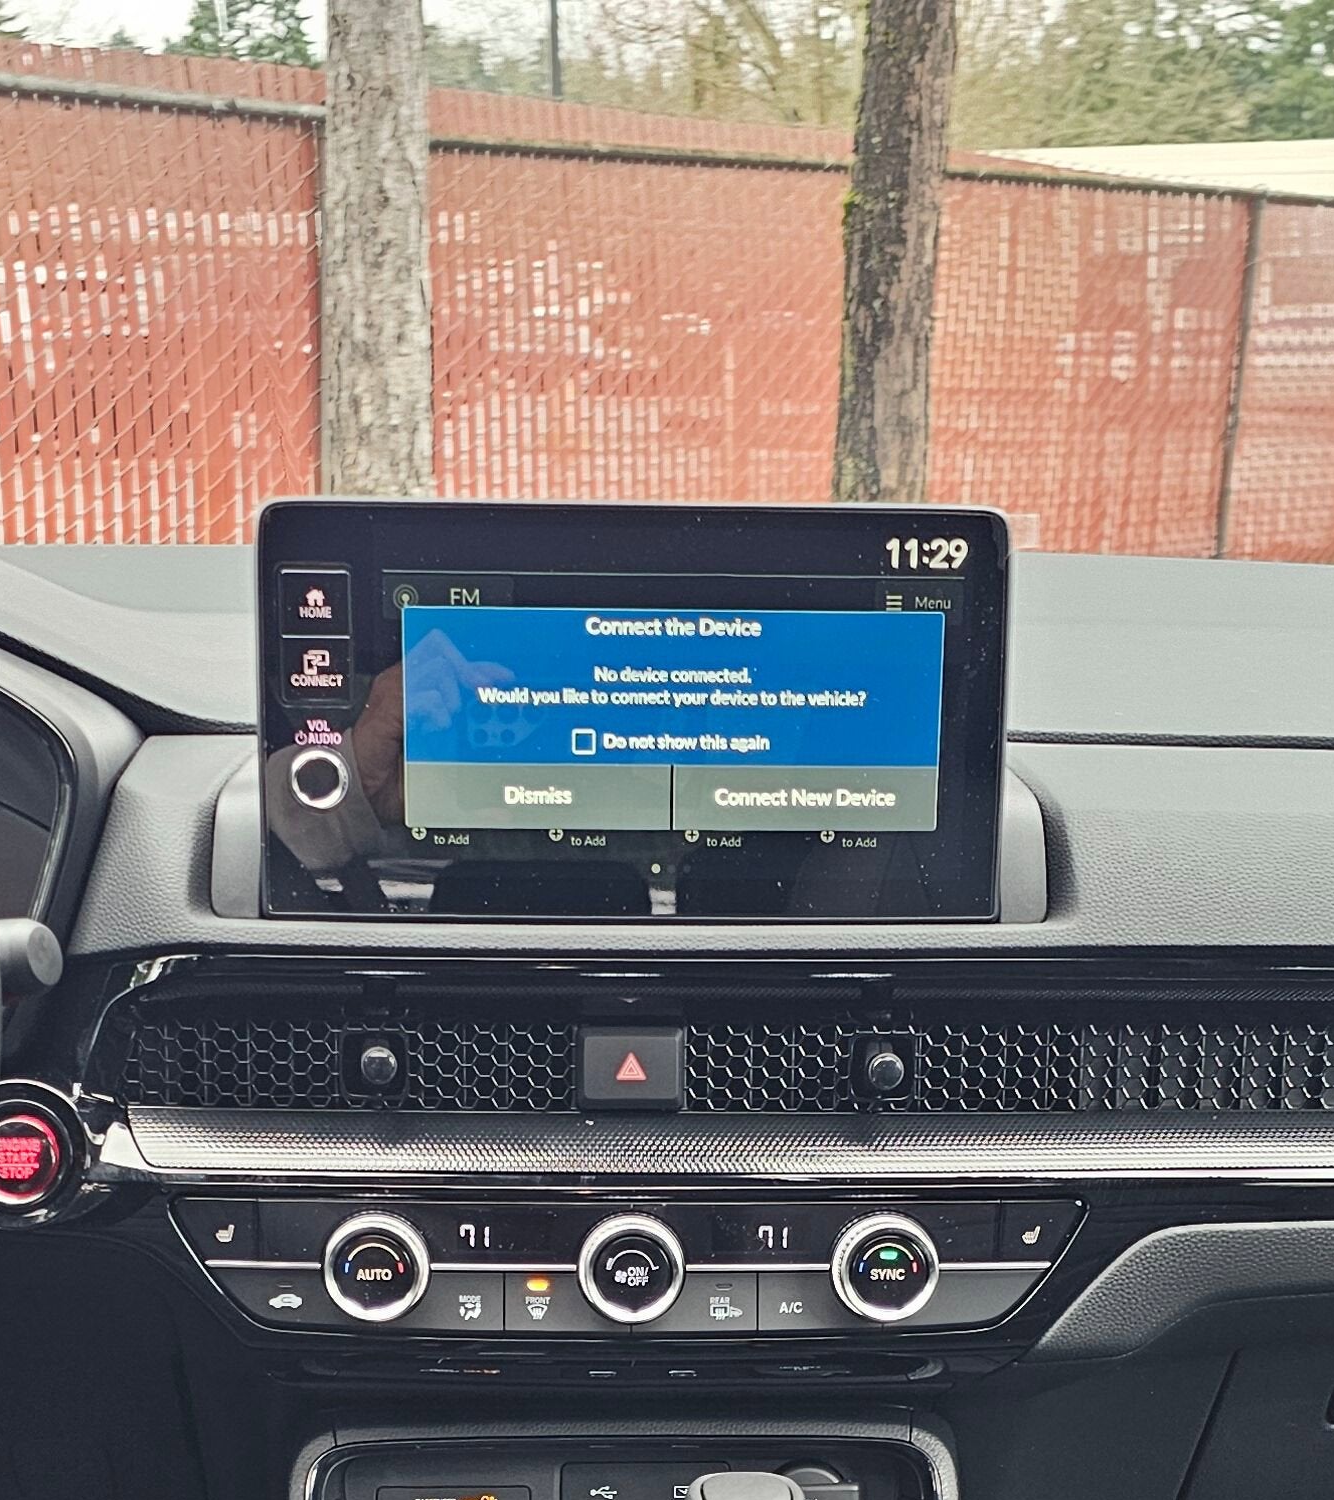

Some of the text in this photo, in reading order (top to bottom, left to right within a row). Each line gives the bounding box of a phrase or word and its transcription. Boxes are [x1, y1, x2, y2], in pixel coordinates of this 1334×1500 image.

[886, 537, 969, 569] 11:29
[450, 588, 480, 605] FM
[915, 596, 952, 609] Menu
[299, 607, 332, 618] HOME
[585, 616, 762, 637] Connect the Device
[291, 674, 343, 687] CONNECT
[593, 666, 752, 684] No device connected.
[478, 687, 867, 708] Would you like to connect your device to the vehicle?
[307, 720, 330, 731] VOL
[308, 733, 341, 745] AUDIO
[603, 733, 771, 753] Do not show this again
[504, 786, 572, 805] Dismiss
[714, 788, 896, 807] Connect New Device
[434, 834, 470, 846] to Add
[571, 836, 606, 847] to Add
[706, 837, 741, 848] to Add
[842, 837, 877, 848] to Add
[0, 1167, 34, 1179] STOP
[356, 1268, 392, 1282] AUTO
[869, 1268, 906, 1281] SYNC
[627, 1277, 649, 1287] OFF
[525, 1296, 551, 1304] FRONT
[710, 1296, 731, 1304] REAR
[779, 1301, 803, 1315] A/C
